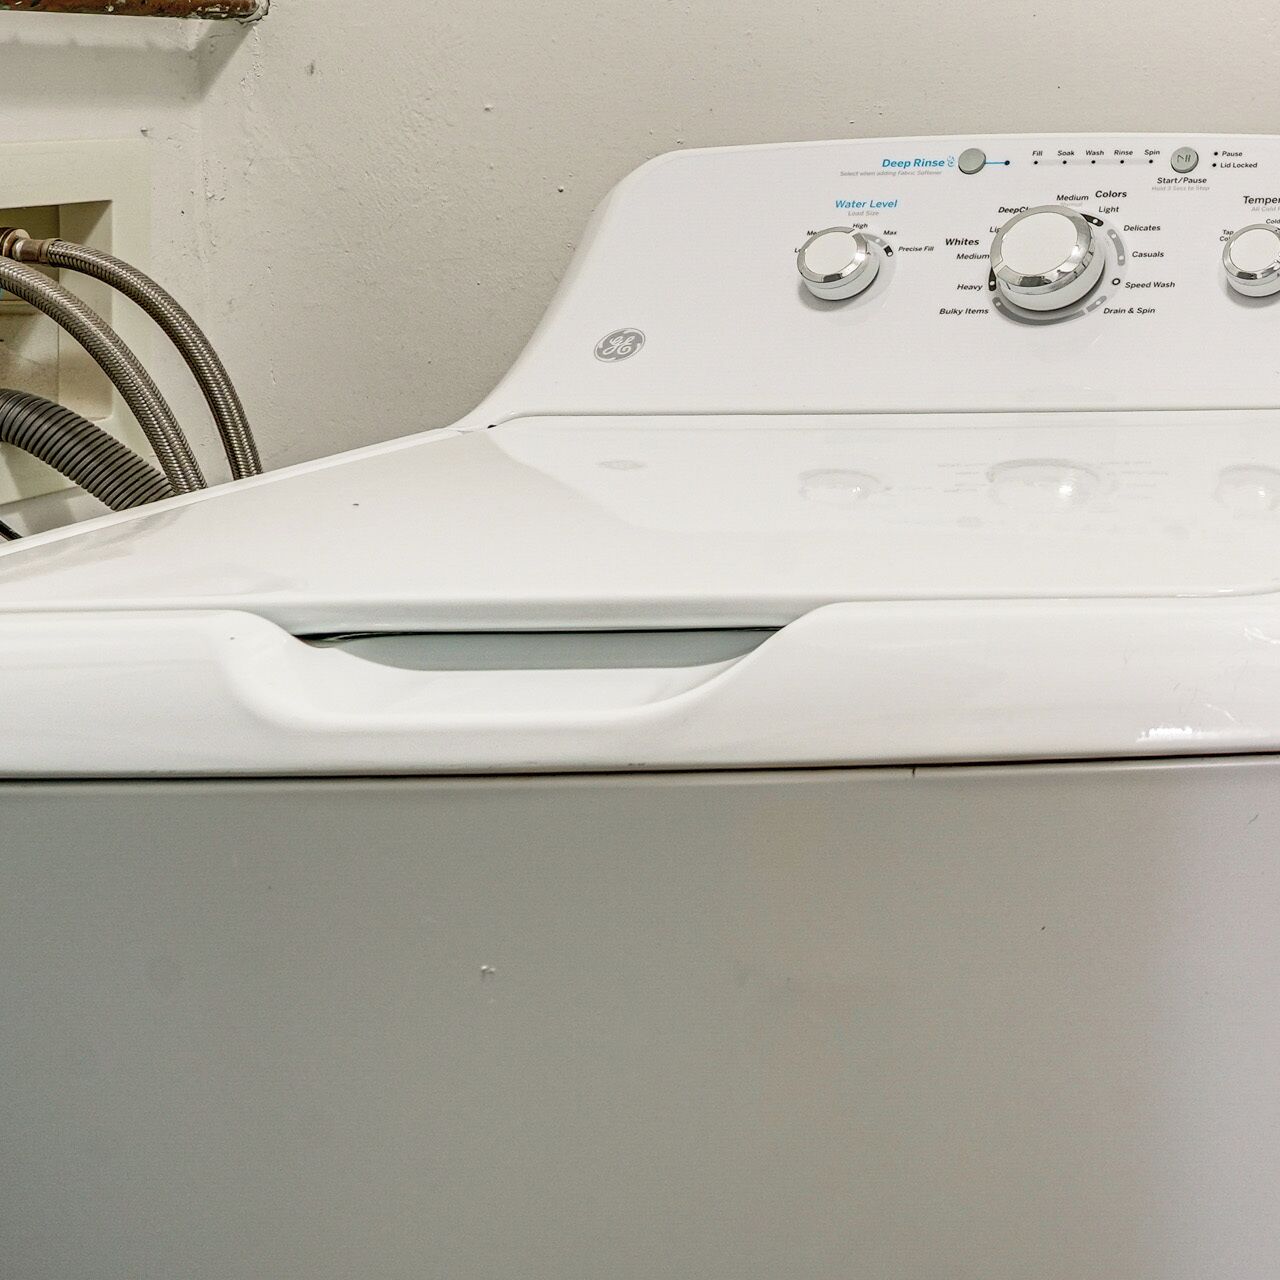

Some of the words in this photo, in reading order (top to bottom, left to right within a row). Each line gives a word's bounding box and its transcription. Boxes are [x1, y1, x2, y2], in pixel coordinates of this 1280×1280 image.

[882, 158, 911, 169] Deep
[913, 158, 945, 167] Rinse
[1095, 190, 1128, 198] Colors
[835, 200, 866, 209] Water
[870, 200, 898, 208] Level
[1098, 206, 1120, 214] Light
[1123, 224, 1161, 232] Delicates
[945, 238, 980, 246] Whites
[956, 284, 983, 292] Heavy
[1125, 281, 1151, 289] Speed
[1137, 307, 1156, 315] Spin
